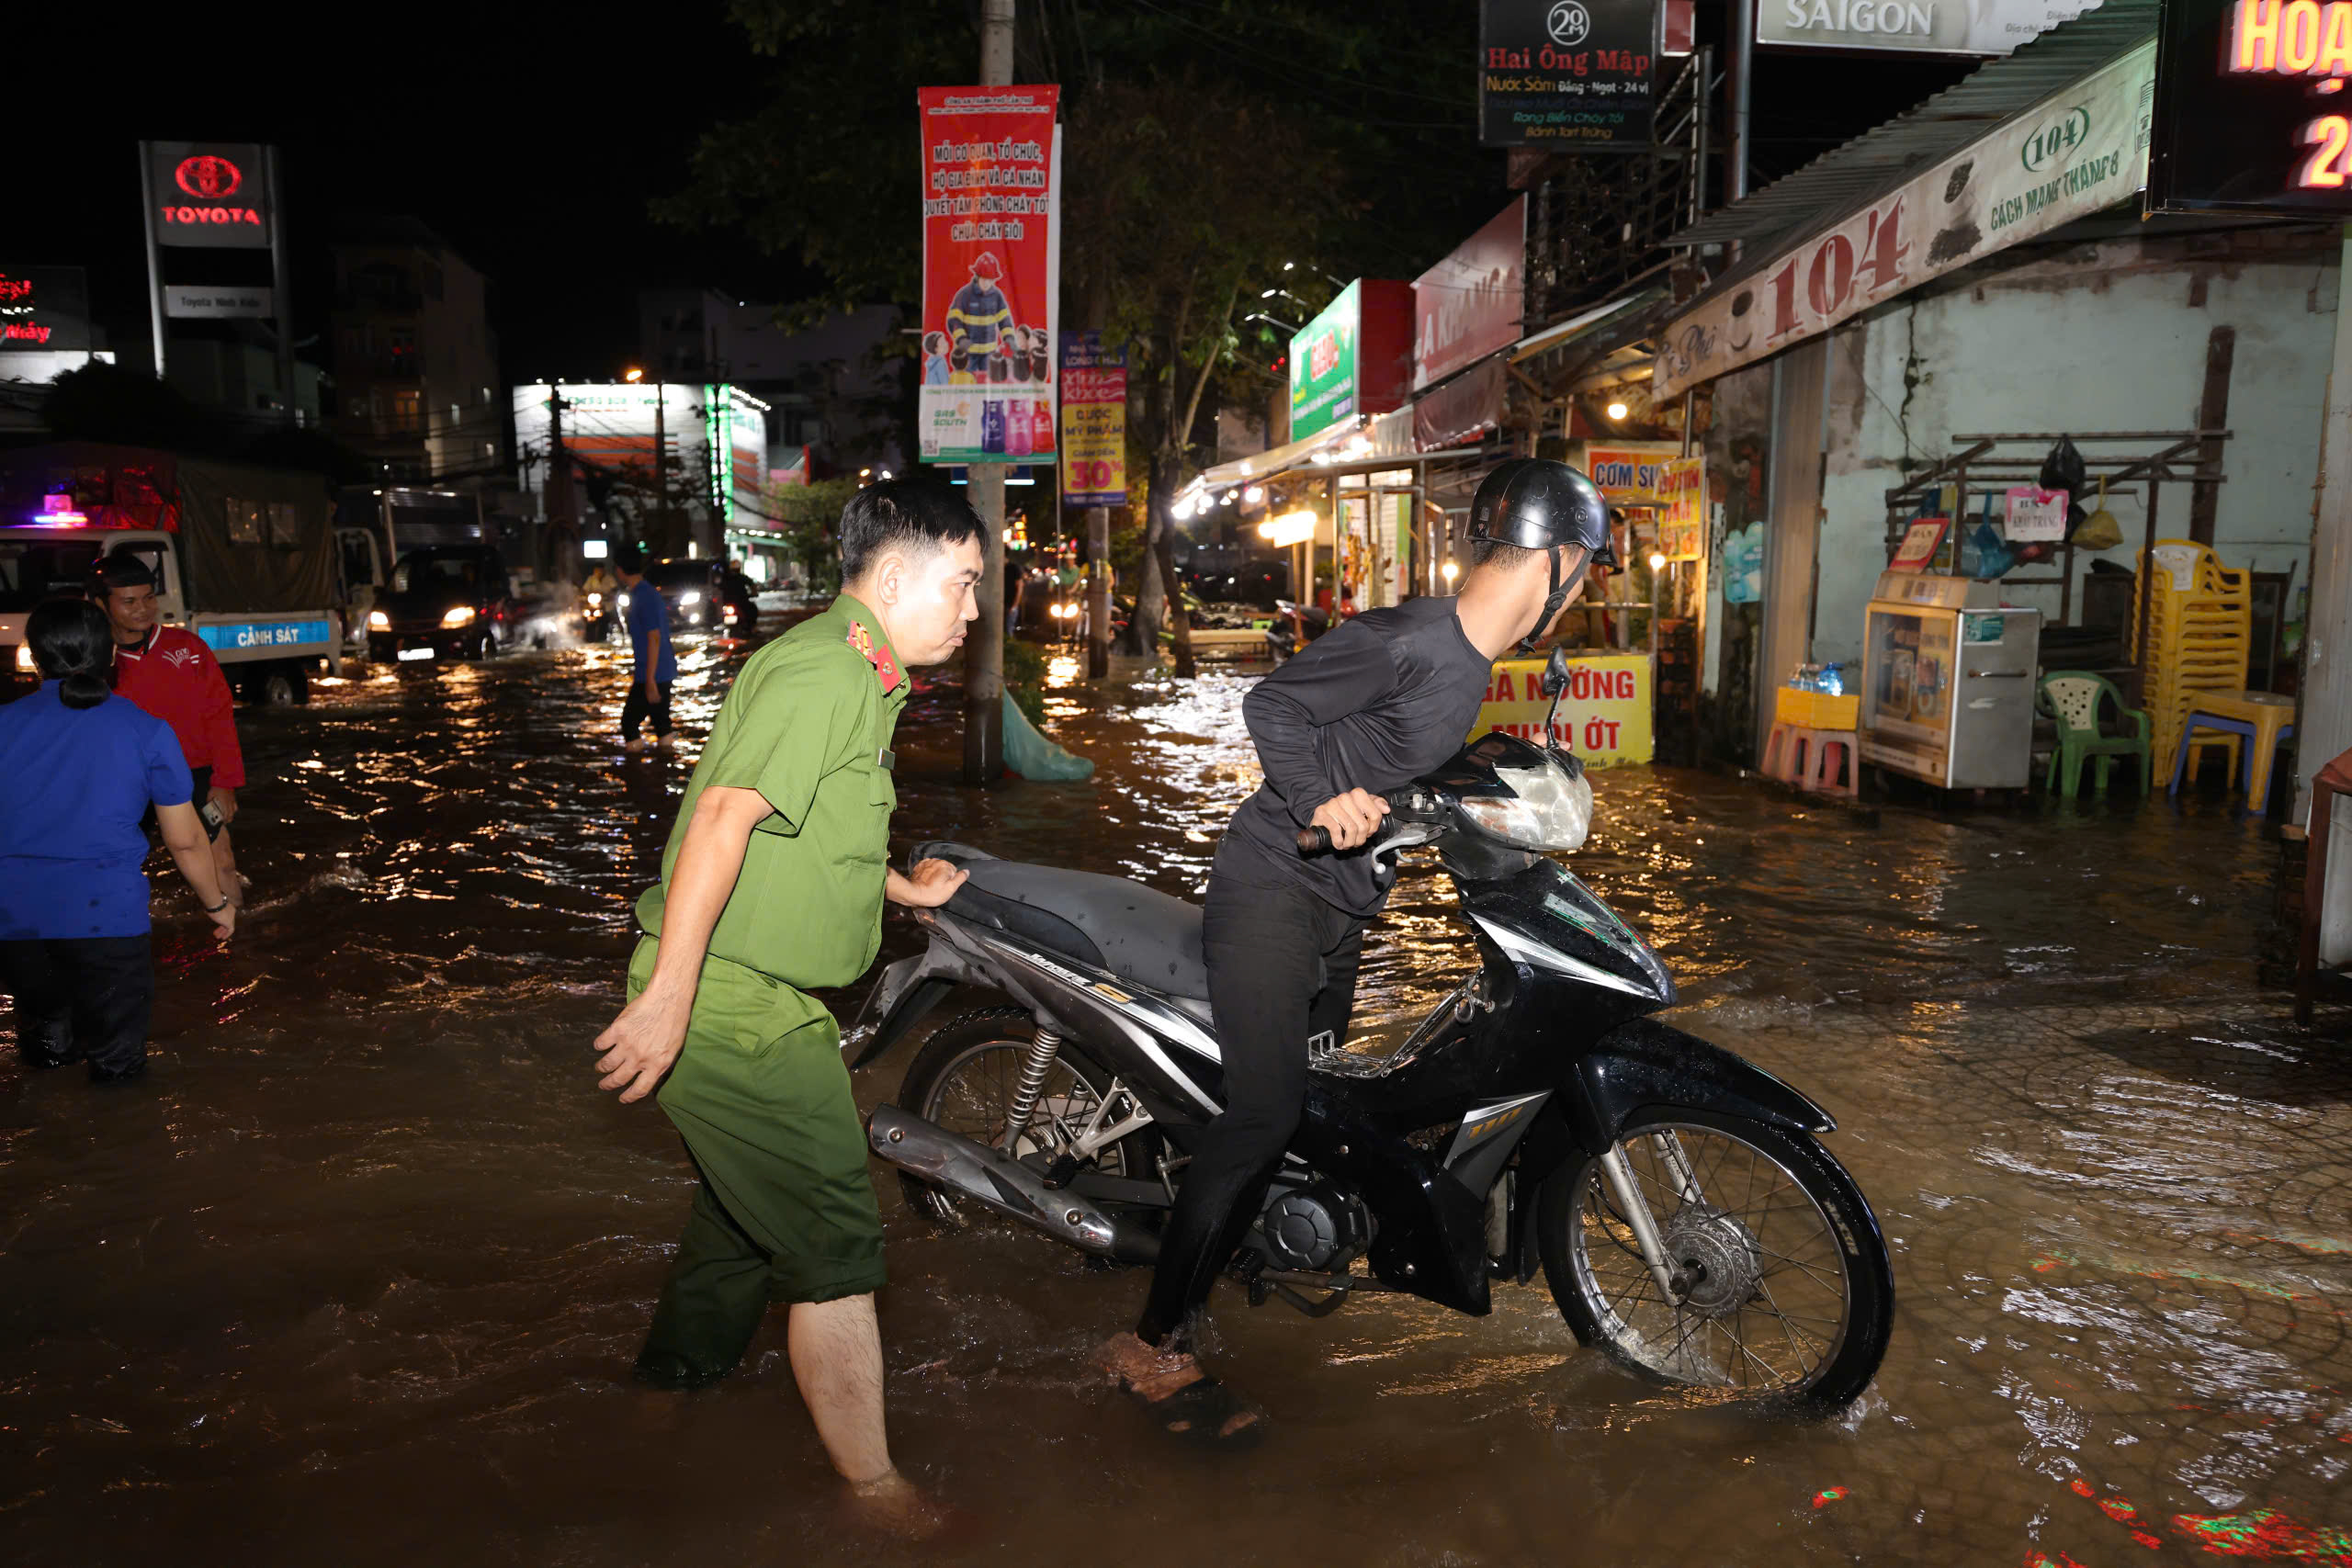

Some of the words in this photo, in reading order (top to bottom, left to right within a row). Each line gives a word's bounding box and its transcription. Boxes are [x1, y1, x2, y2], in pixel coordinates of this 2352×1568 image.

[1786, 0, 1932, 35] SAIGON
[1487, 47, 1532, 70] Hai
[1539, 43, 1589, 76] Ông
[1597, 50, 1649, 77] Mập
[1487, 76, 1521, 92] Nước
[1624, 82, 1641, 94] 24
[1642, 82, 1650, 95] vị
[954, 143, 968, 160] CƠ
[2030, 115, 2078, 165] 104
[933, 170, 946, 192] HỘ
[948, 172, 964, 188] GIA
[965, 168, 986, 188] ĐÌNH
[988, 166, 1001, 186] VÀ
[1002, 167, 1016, 187] CÁ
[1017, 168, 1045, 187] NHÂN
[1991, 197, 2023, 231] CÁCH
[2026, 176, 2062, 216] MẠNG
[2064, 155, 2110, 197] THÁNG
[2109, 150, 2120, 177] 8
[161, 206, 261, 226] TOYOTA
[953, 195, 972, 214] TÂM
[974, 193, 1003, 212] PHÒNG
[1005, 194, 1031, 213] CHÁY
[952, 222, 976, 241] CHỮA
[977, 220, 1002, 240] CHÁY
[1003, 220, 1024, 239] GIỎI
[1766, 195, 1911, 349] 104
[181, 296, 211, 309] Toyota
[1596, 460, 1633, 487] CƠM
[237, 626, 273, 648] CẢNH
[275, 626, 300, 644] SÁT
[1525, 665, 1635, 702] NỚNG
[1584, 716, 1621, 751] ỚT
